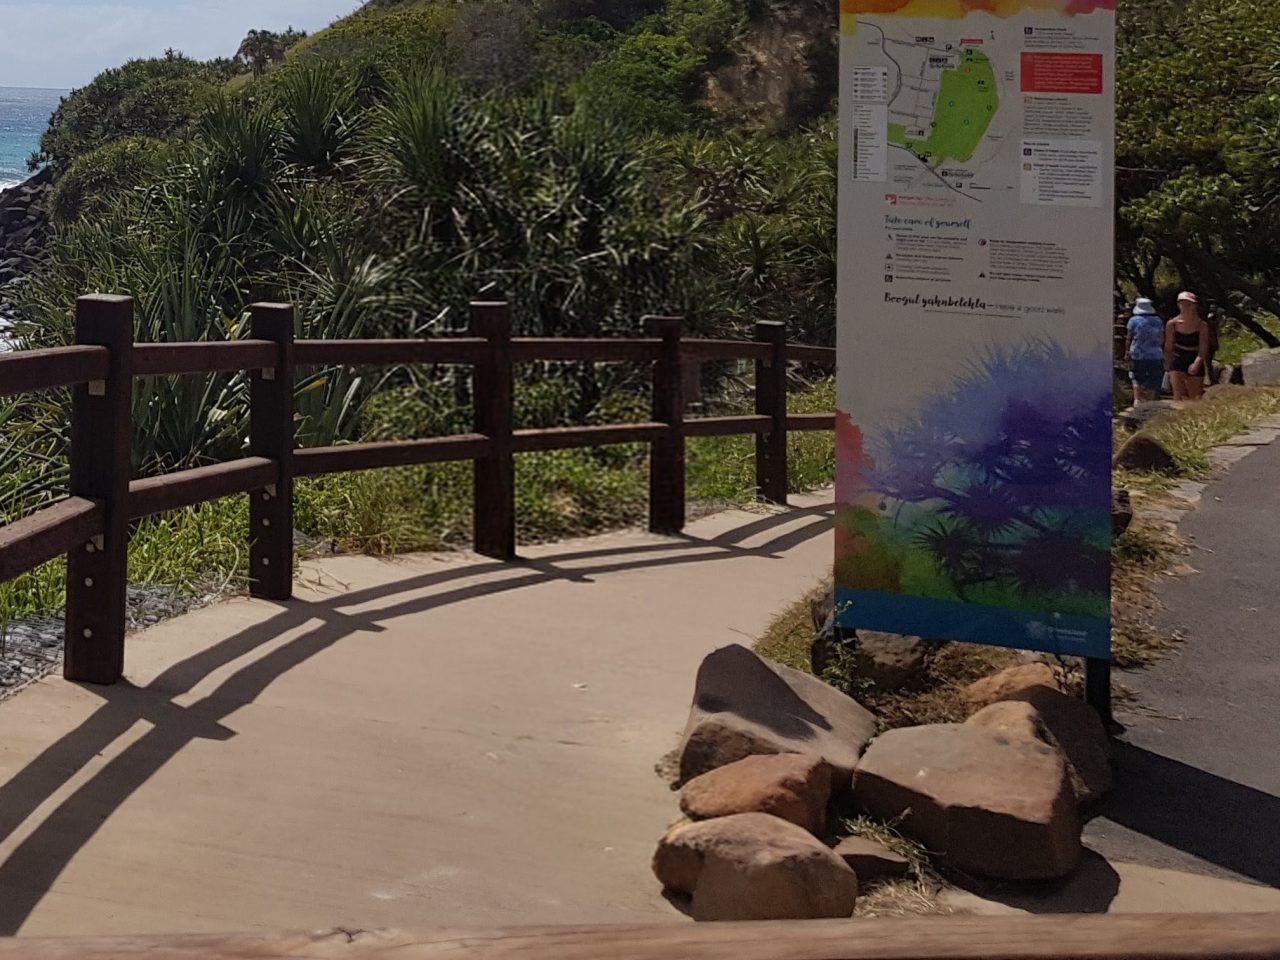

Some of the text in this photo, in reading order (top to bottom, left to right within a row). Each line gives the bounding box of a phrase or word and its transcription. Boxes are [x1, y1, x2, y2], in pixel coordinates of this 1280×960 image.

[923, 216, 934, 228] of
[935, 219, 970, 230] yourself
[884, 292, 920, 306] Boogul
